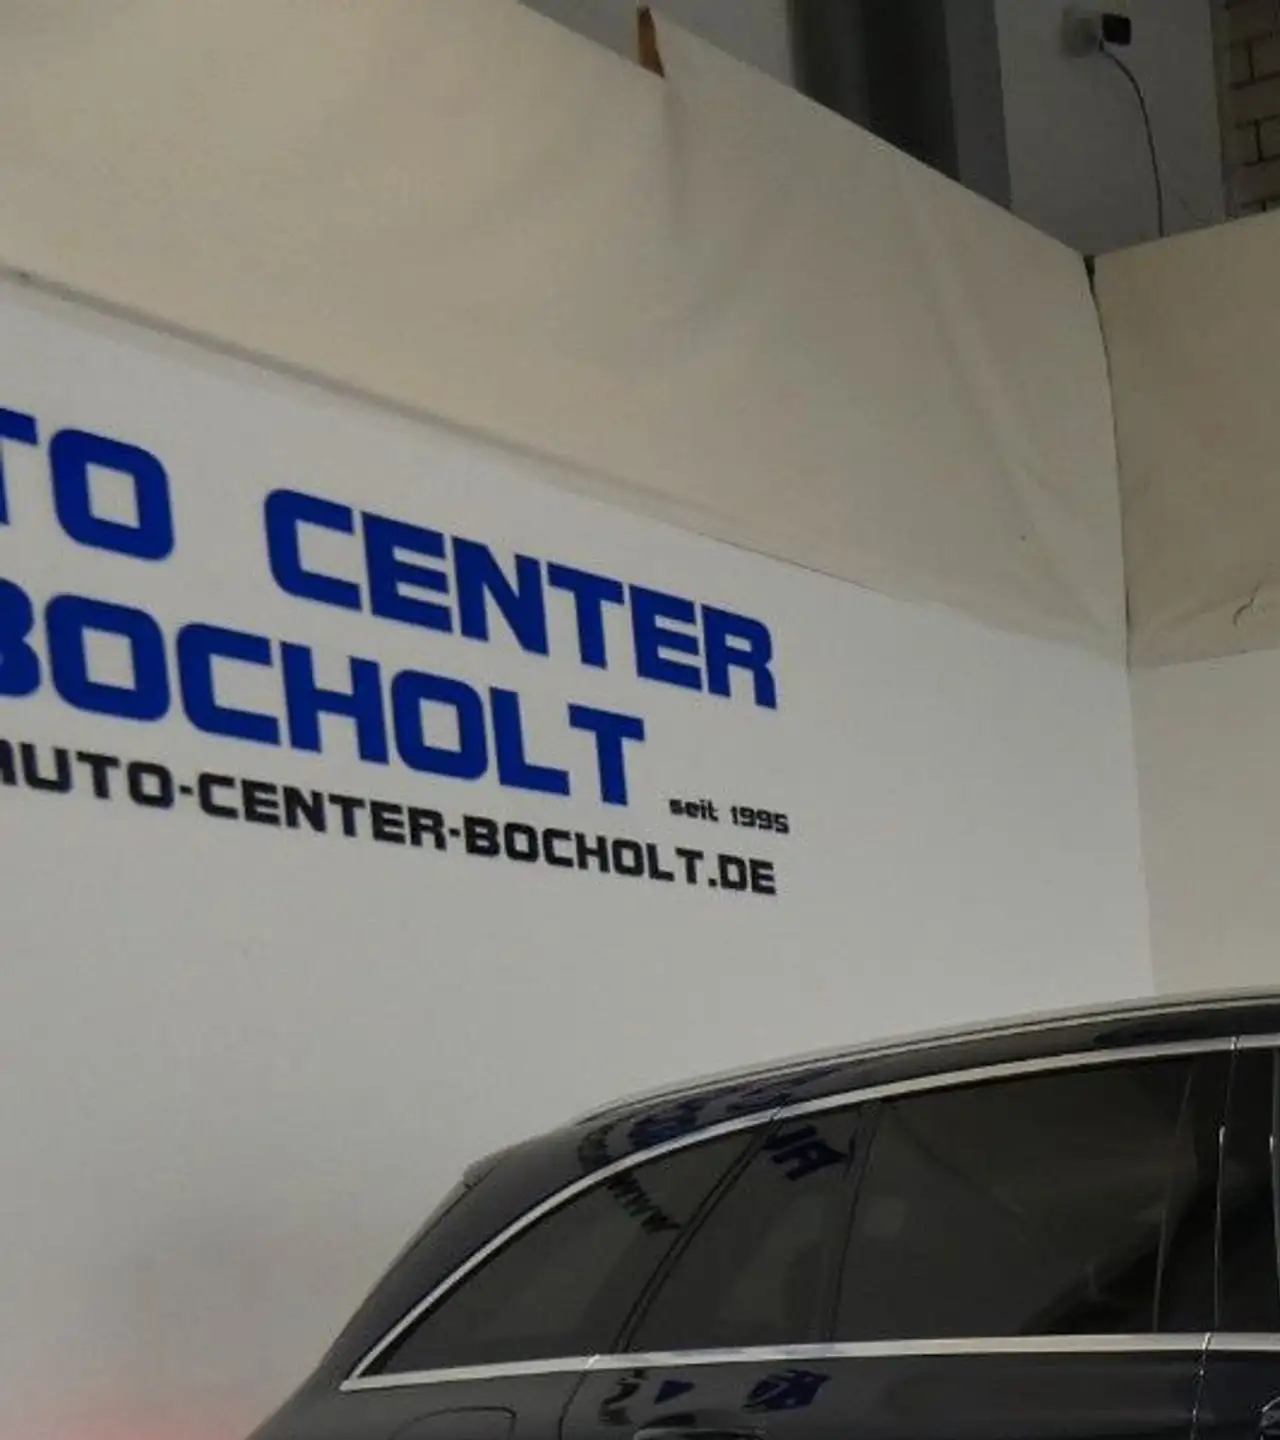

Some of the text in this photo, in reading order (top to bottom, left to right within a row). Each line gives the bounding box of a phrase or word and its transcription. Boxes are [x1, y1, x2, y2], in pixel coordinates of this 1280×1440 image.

[266, 489, 777, 708] CENTER
[669, 798, 790, 834] seit 1995
